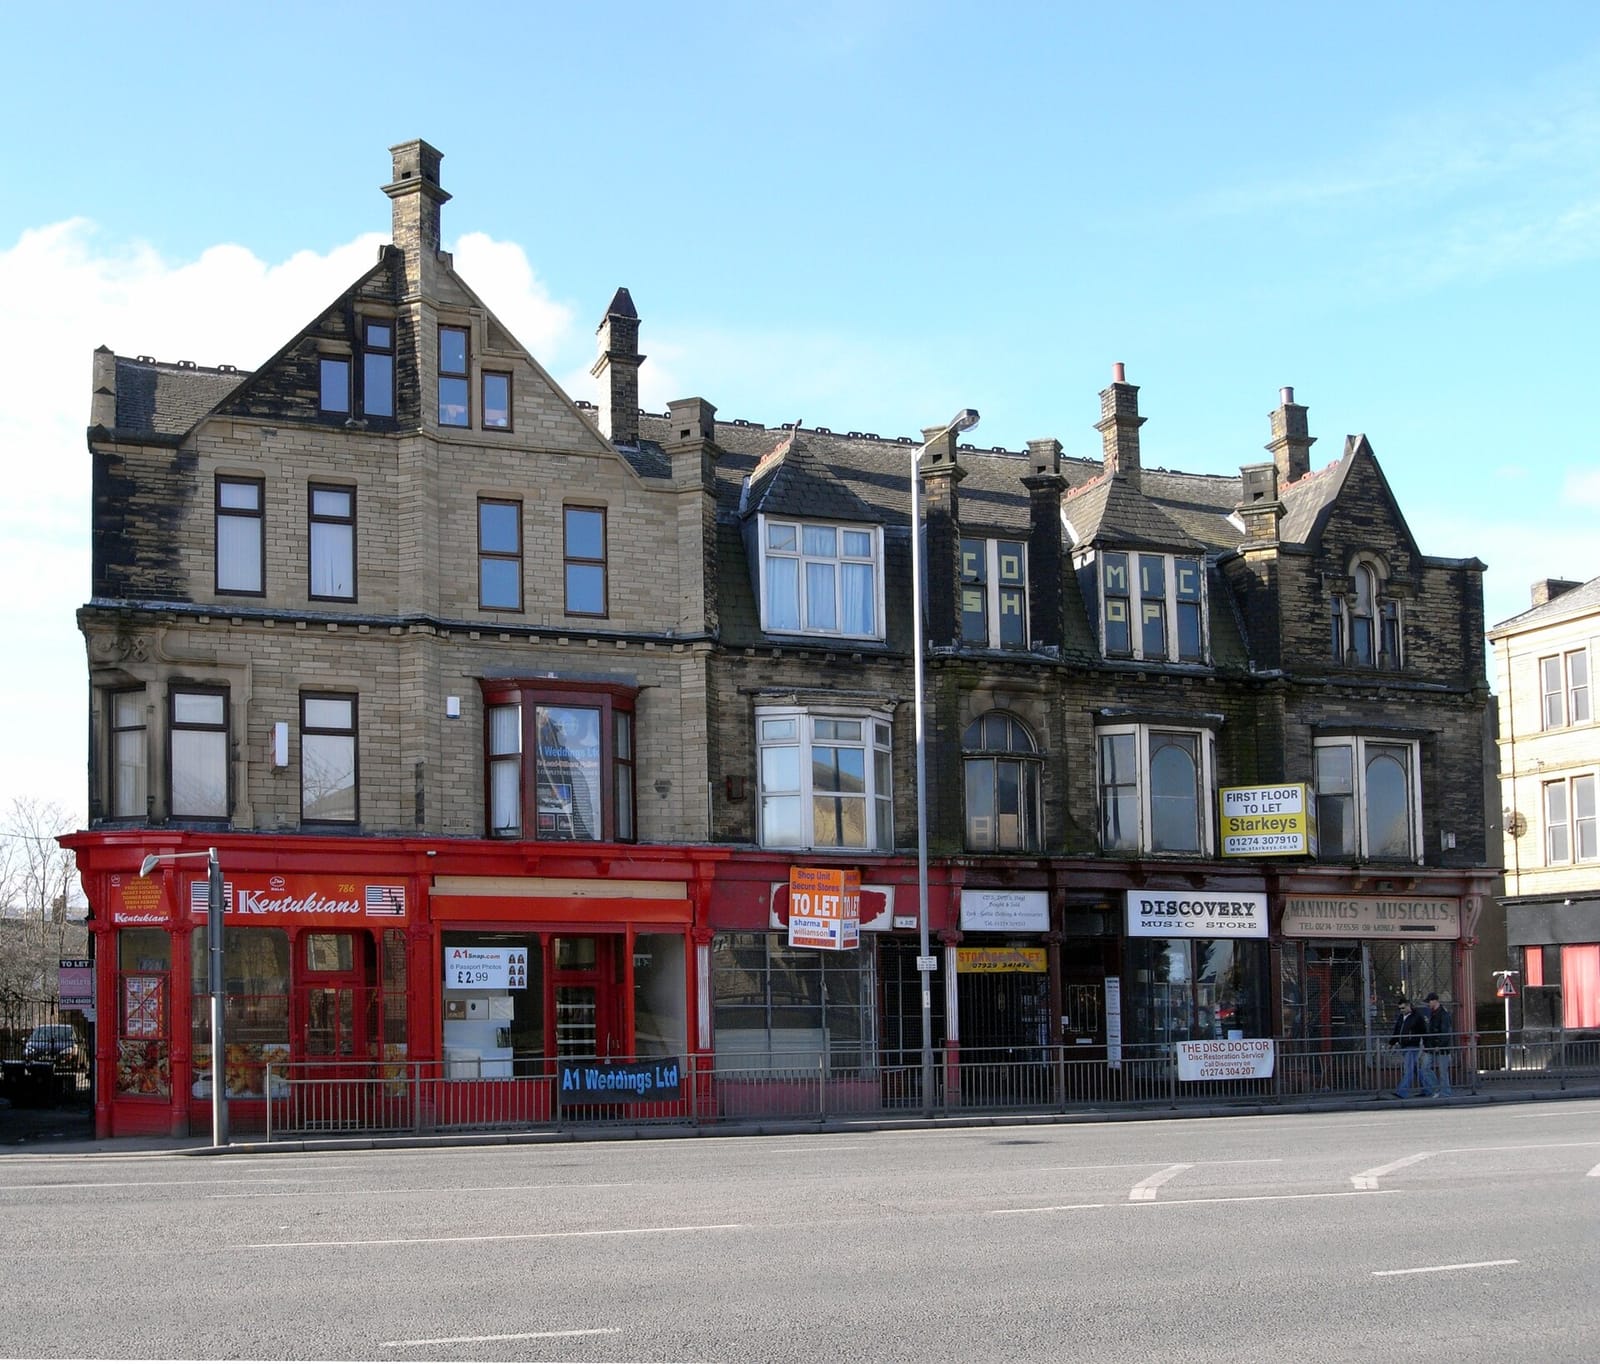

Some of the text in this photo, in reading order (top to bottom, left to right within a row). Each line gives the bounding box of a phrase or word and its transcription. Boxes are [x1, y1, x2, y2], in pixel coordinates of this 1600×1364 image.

[1226, 789, 1298, 803] FIRST FLOOR
[1243, 803, 1282, 814] TO LET
[1229, 817, 1297, 832] Starkeys
[1229, 835, 1298, 847] 01274 307910
[798, 870, 831, 880] Shop Unit
[336, 883, 355, 893] 786
[792, 881, 840, 892] Secure Stores
[237, 889, 361, 914] Kentukians
[792, 893, 839, 918] TO LET
[1140, 900, 1256, 917] DISCOVERY
[1290, 900, 1359, 919] MANNINGS
[1375, 902, 1449, 921] MUSICALS
[114, 912, 169, 923] Kentukians
[794, 919, 821, 927] sharma
[794, 928, 828, 937] williamson
[456, 963, 481, 971] Passport
[1181, 1041, 1270, 1053] THE DISC DOCTOR
[1188, 1053, 1203, 1061] Disc
[1204, 1052, 1240, 1060] Restoration
[1215, 1060, 1242, 1068] Discovery
[1200, 1066, 1256, 1077] 01274 304 207
[562, 1065, 679, 1094] A1 Weddings Ltd
